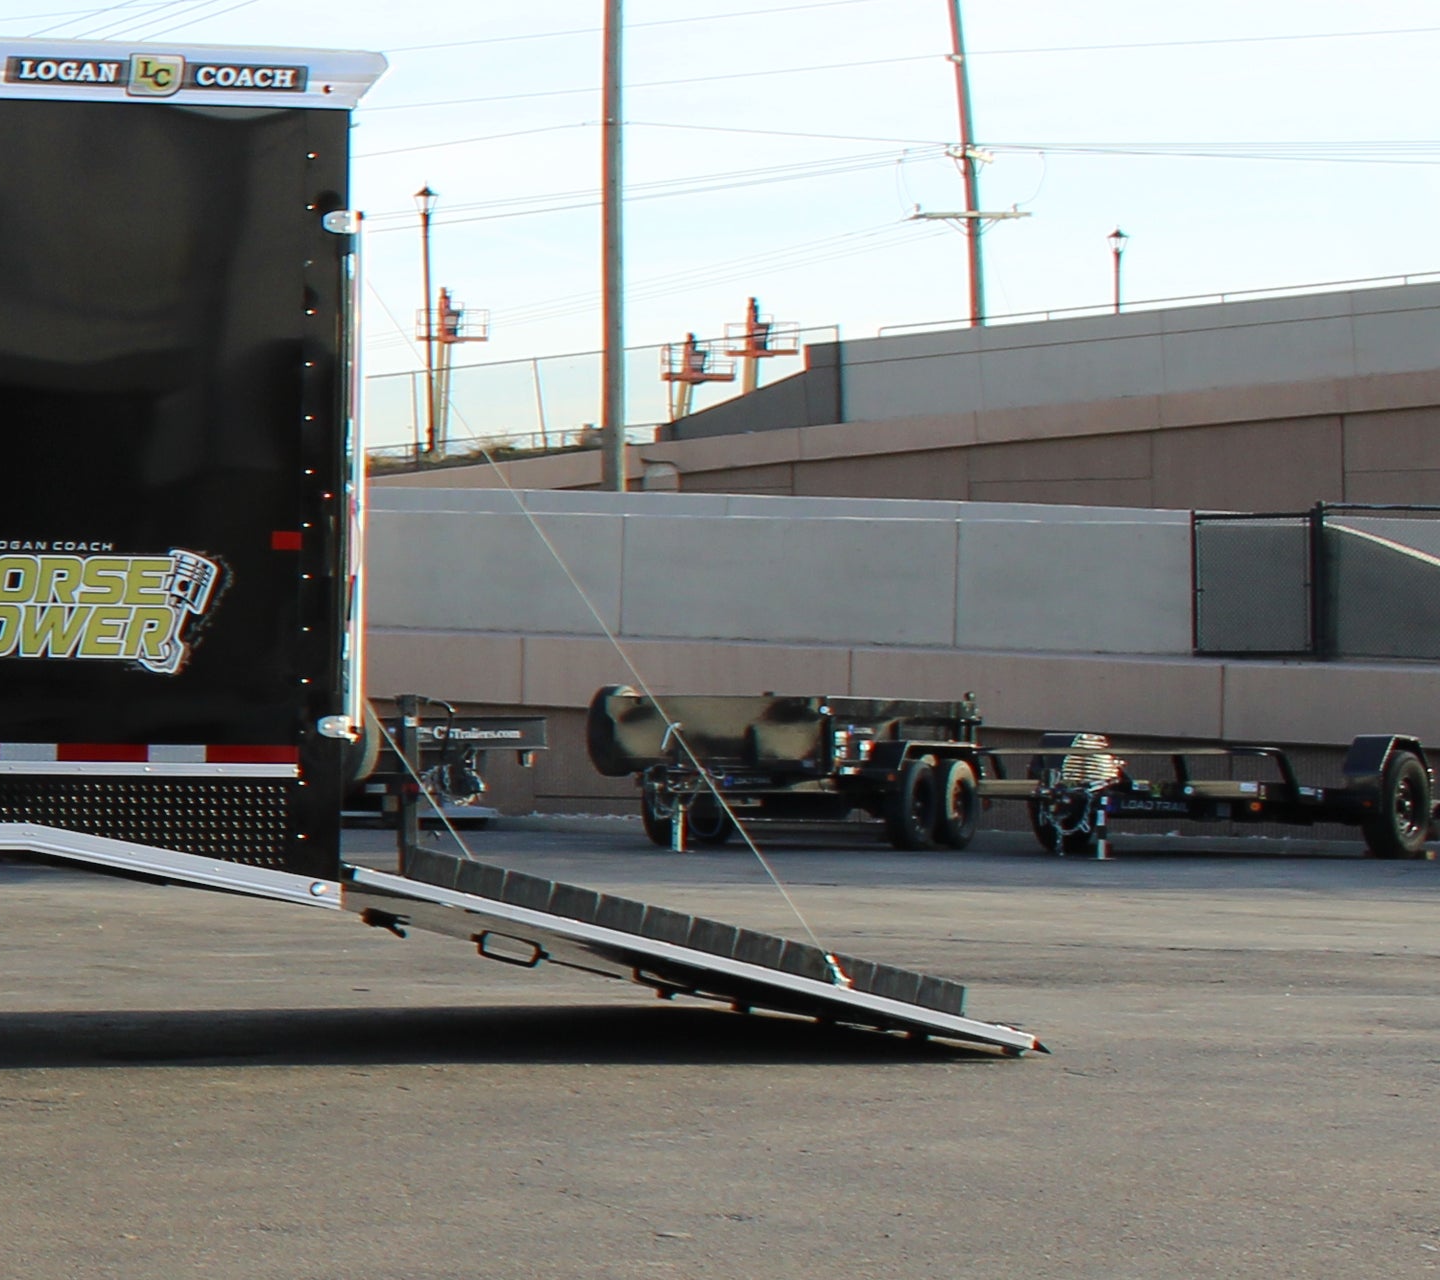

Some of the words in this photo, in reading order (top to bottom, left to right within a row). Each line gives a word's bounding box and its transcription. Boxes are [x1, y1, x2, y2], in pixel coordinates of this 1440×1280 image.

[19, 60, 119, 83] LOGAN
[196, 66, 295, 88] COACH
[52, 541, 113, 551] COACH
